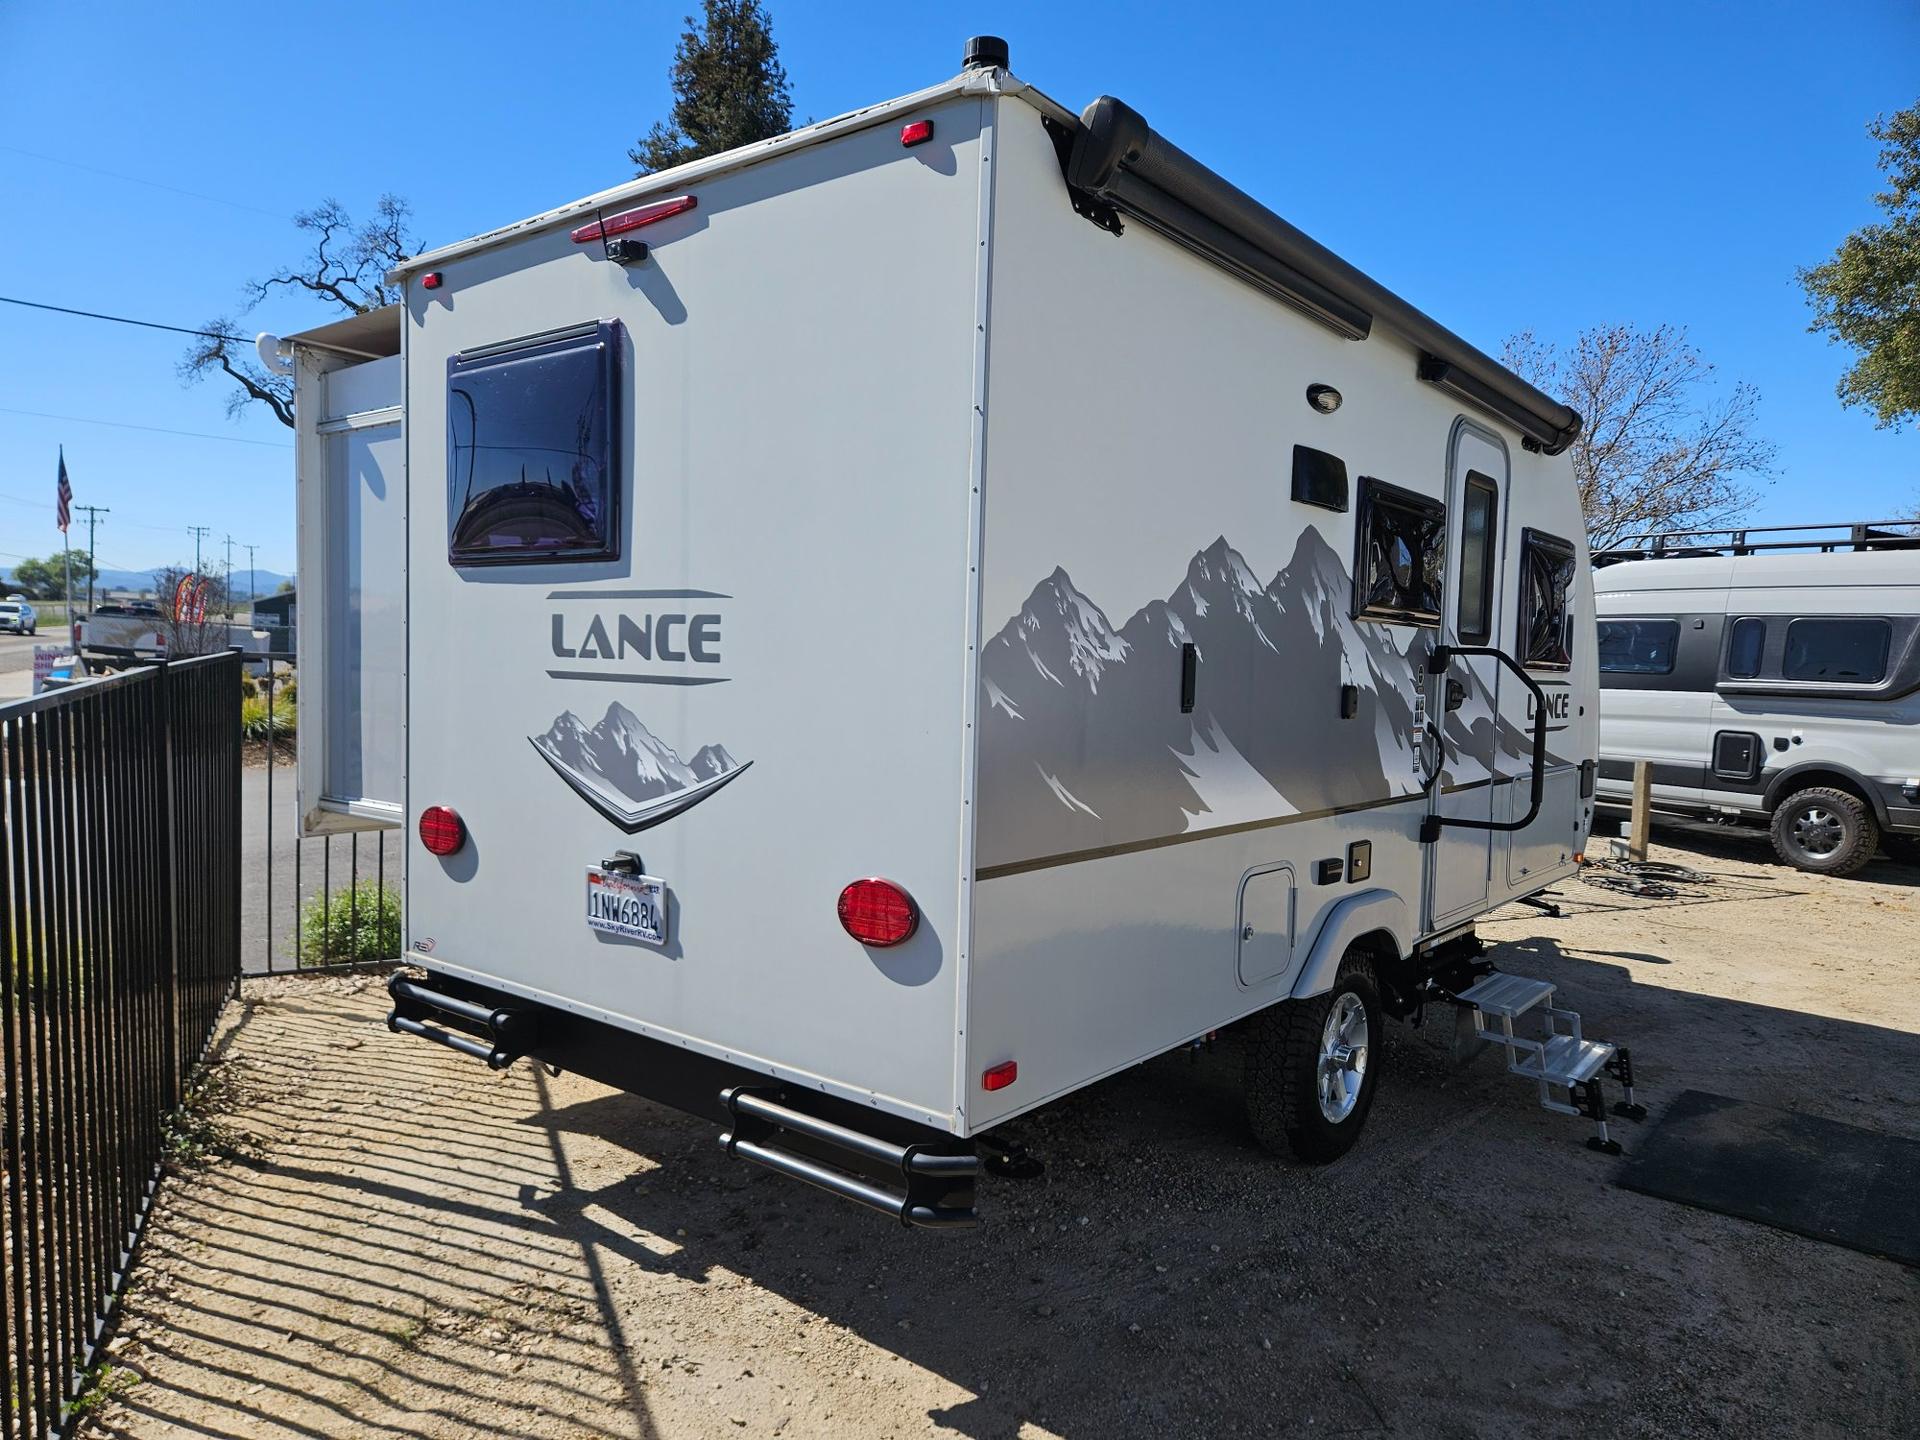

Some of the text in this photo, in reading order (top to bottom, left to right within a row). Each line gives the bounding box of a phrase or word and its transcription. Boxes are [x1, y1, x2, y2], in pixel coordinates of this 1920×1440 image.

[551, 613, 722, 663] LANCE
[1527, 693, 1570, 720] LNCE
[592, 892, 658, 931] 1NW6884
[588, 920, 662, 941] www.SkyRiverRV.com
